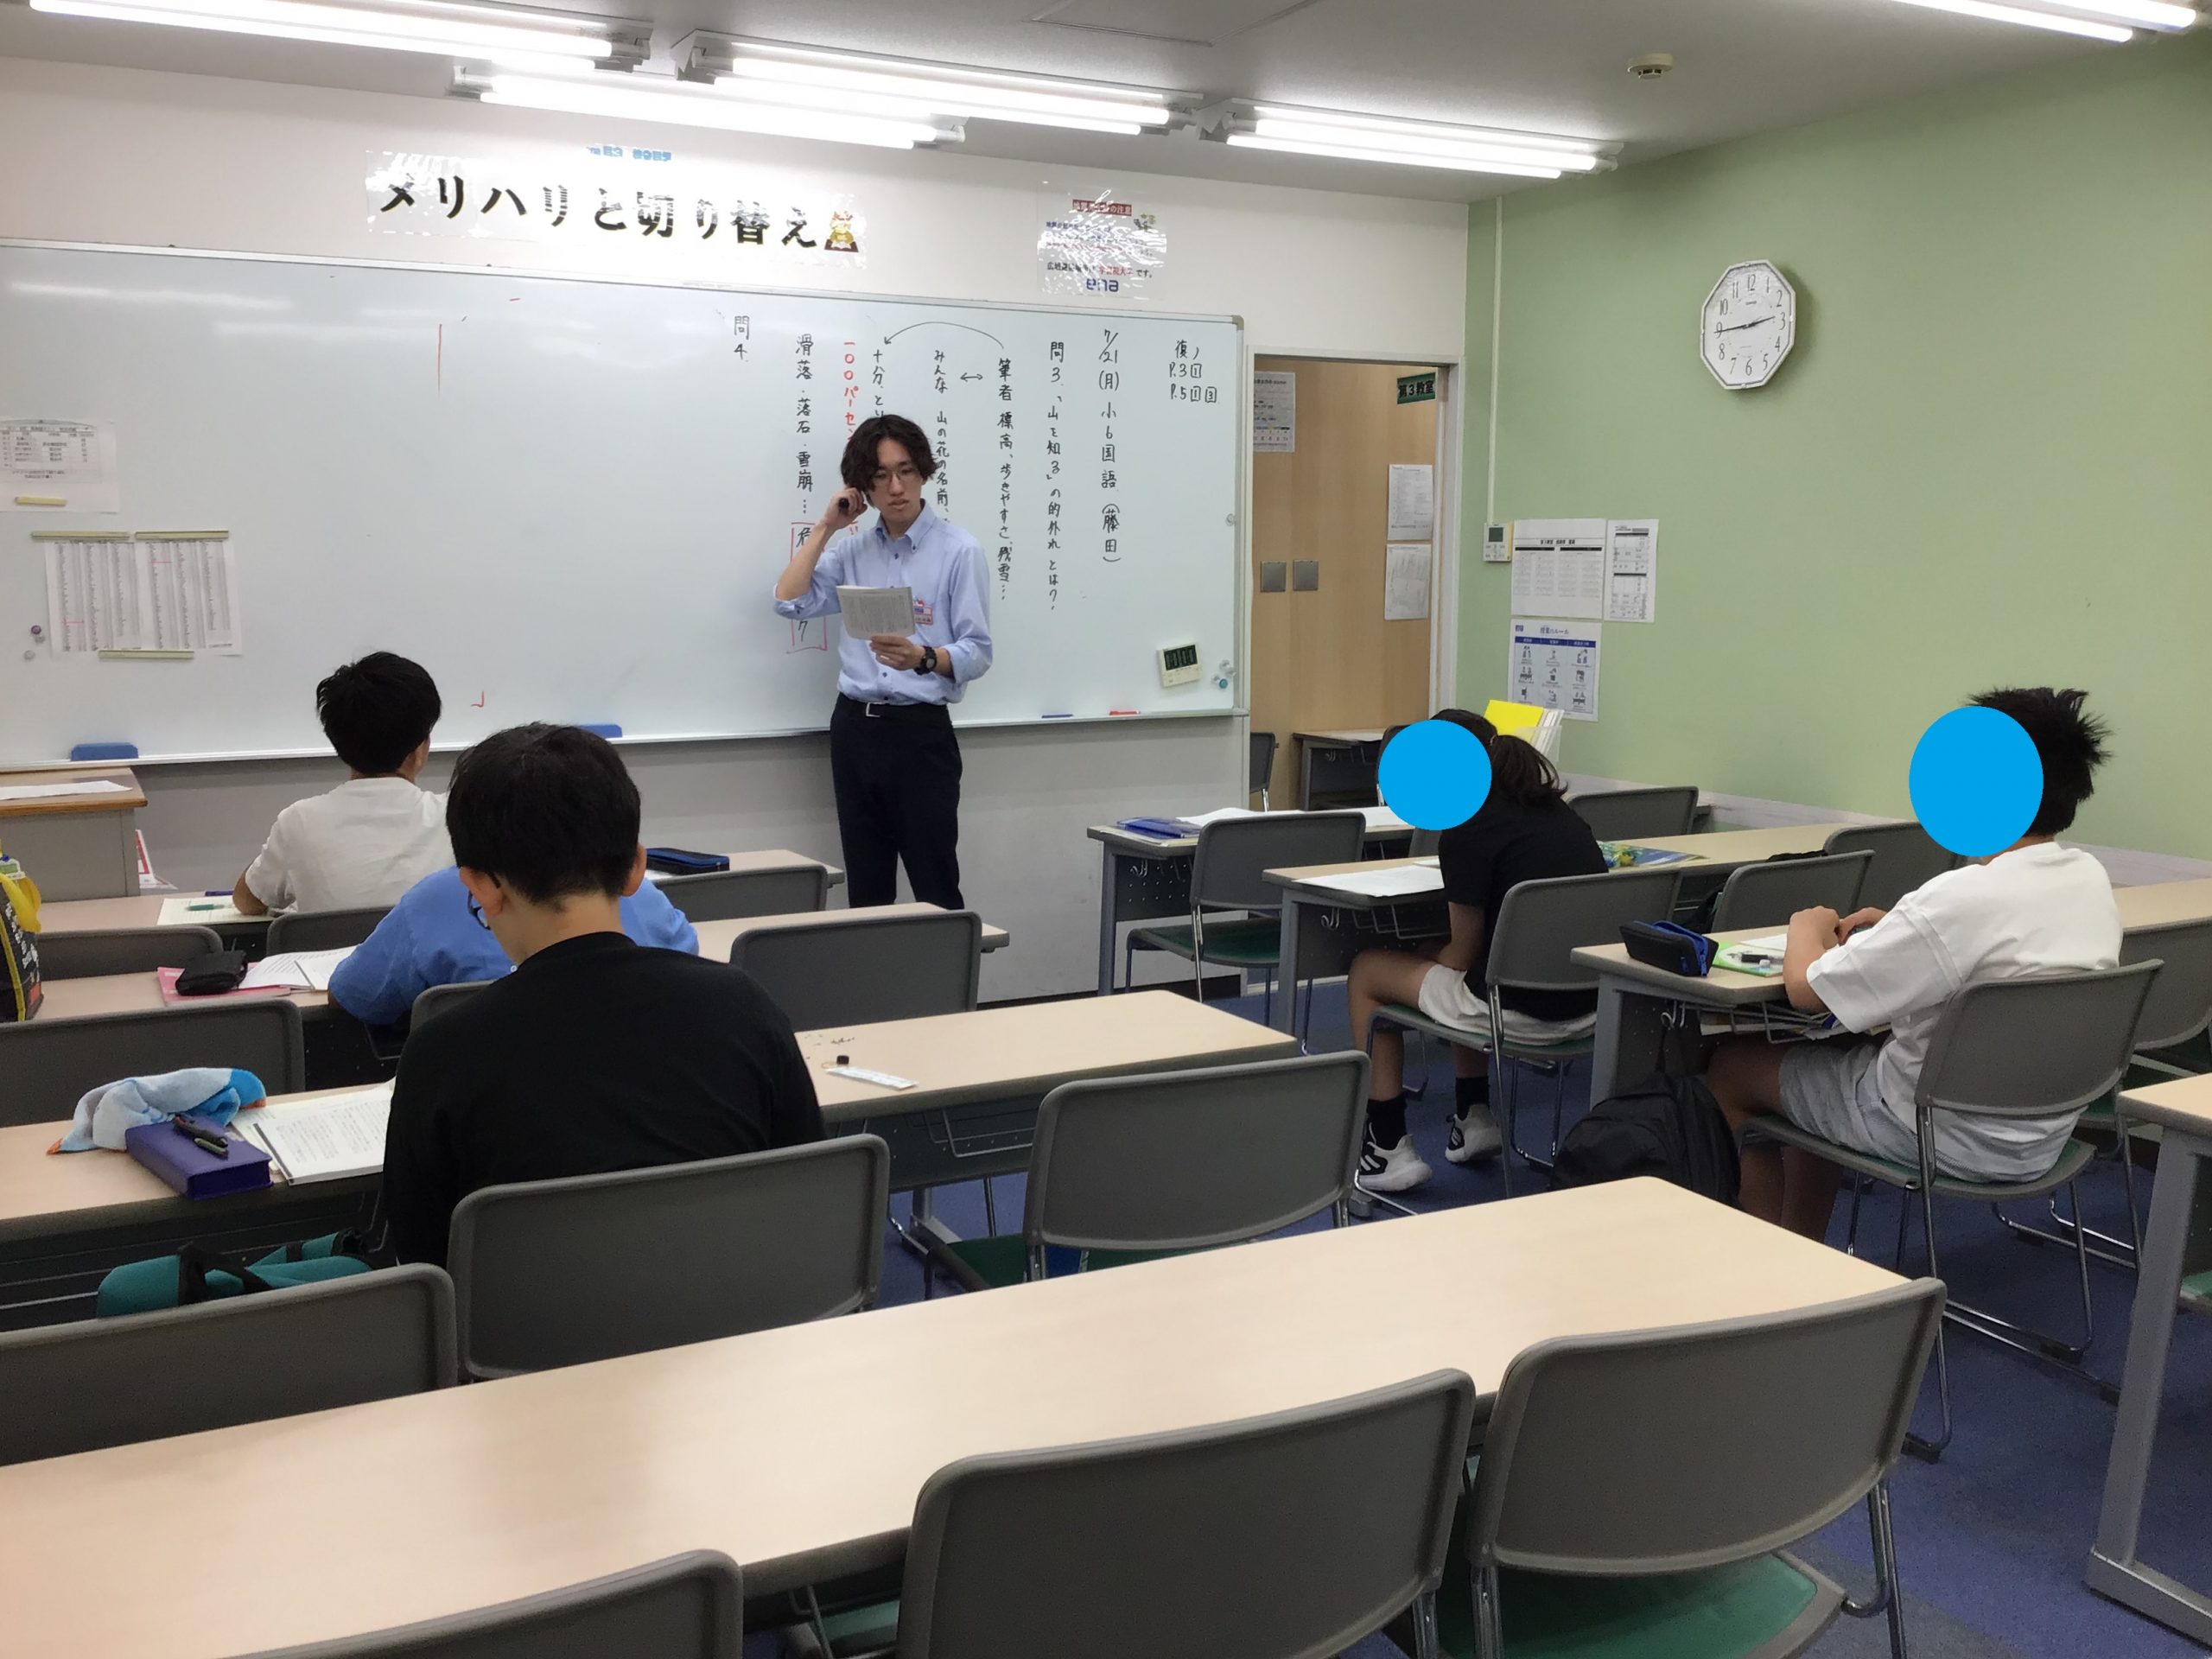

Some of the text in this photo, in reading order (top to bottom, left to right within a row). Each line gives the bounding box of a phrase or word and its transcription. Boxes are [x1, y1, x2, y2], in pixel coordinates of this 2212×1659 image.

[380, 174, 817, 249] メリハリと切り替え
[1086, 277, 1119, 293] ena
[1732, 281, 1739, 299] 11
[1747, 273, 1756, 291] 12
[1719, 298, 1728, 315] 10
[1776, 289, 1783, 308] 2
[1716, 321, 1723, 339] 9
[1779, 312, 1786, 330] 3
[1719, 343, 1726, 359] 8
[1775, 335, 1781, 352] 4
[1730, 357, 1737, 375] 7
[1745, 359, 1752, 376] 6
[1763, 353, 1769, 371] 5
[1397, 379, 1434, 399] 第3教室
